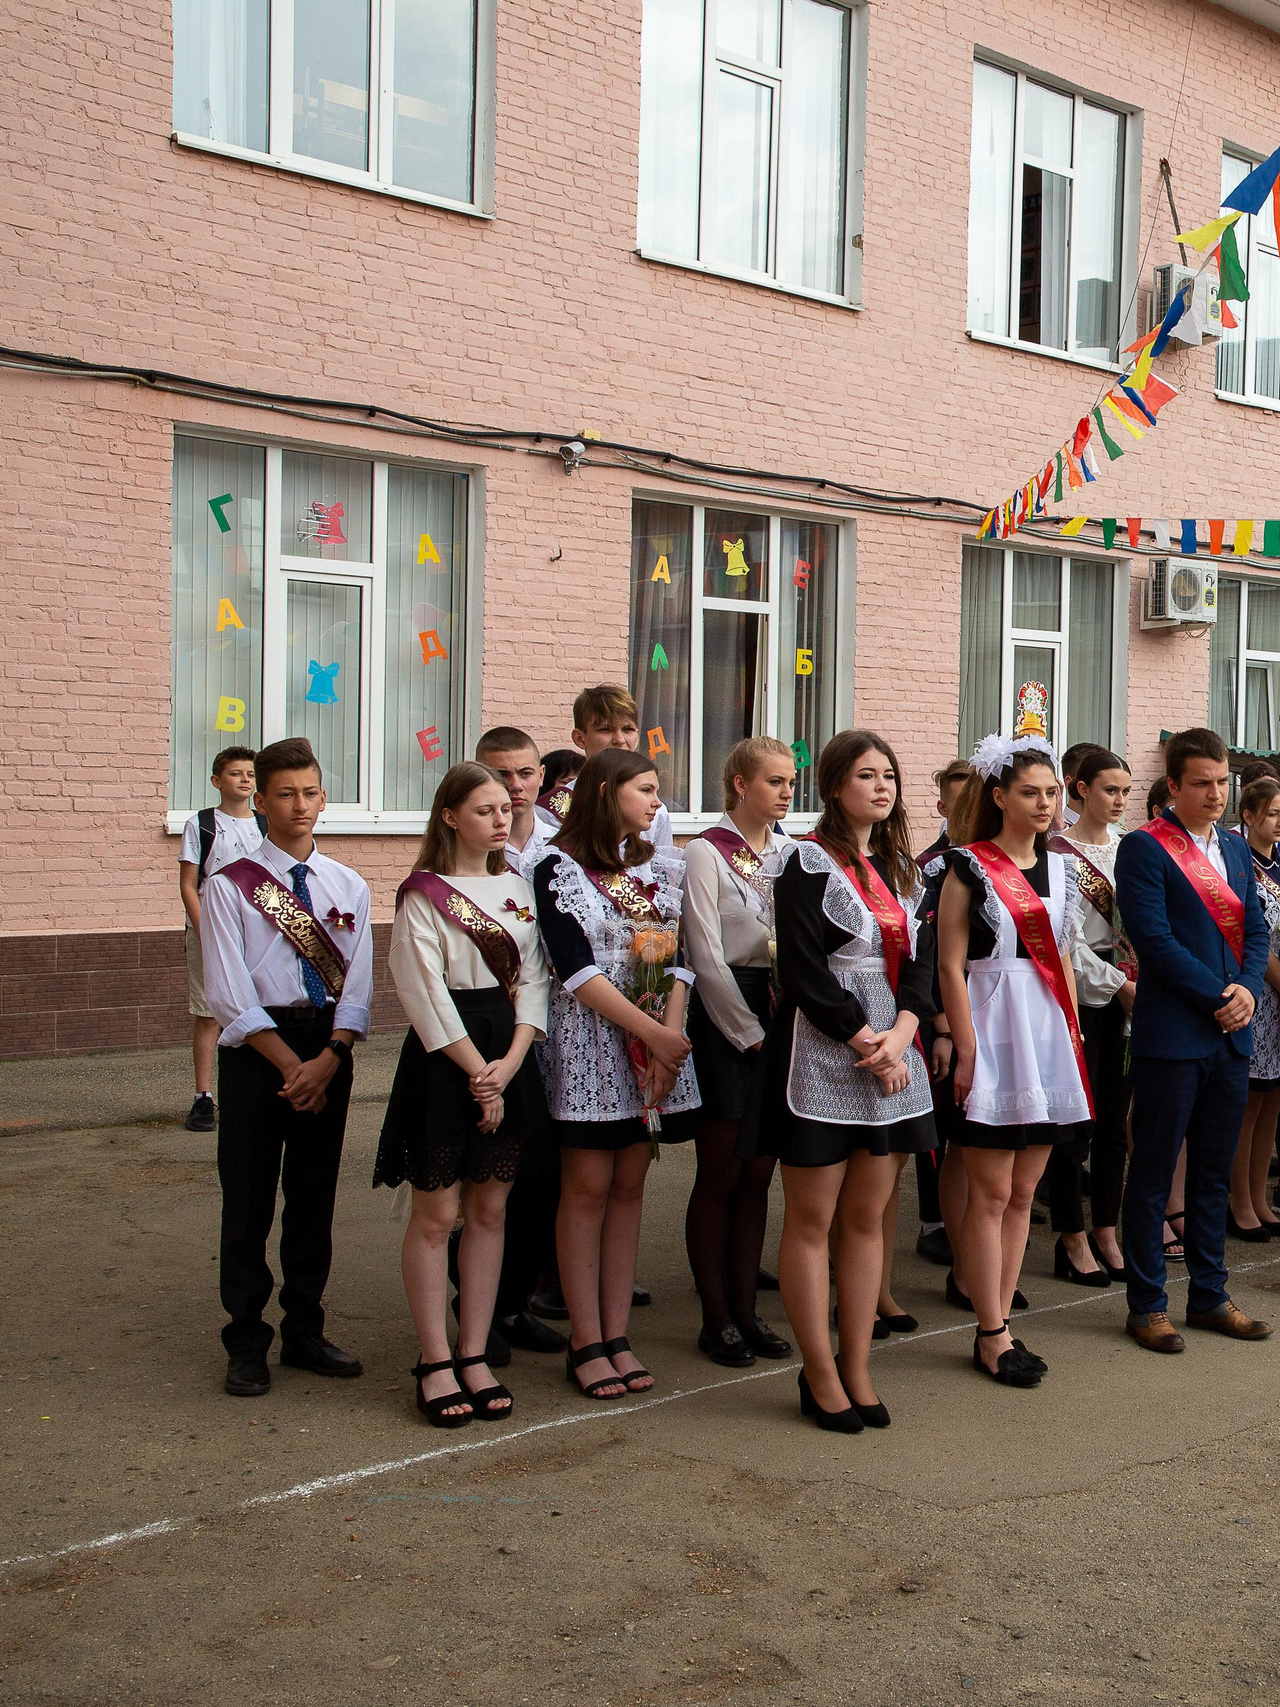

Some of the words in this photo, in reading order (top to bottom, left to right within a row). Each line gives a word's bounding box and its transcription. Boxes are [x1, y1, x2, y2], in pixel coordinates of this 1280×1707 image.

[208, 493, 233, 533] Г
[418, 629, 448, 666] Д
[796, 648, 813, 675] Б
[647, 726, 671, 760] Д
[1001, 870, 1048, 964] Выпуск
